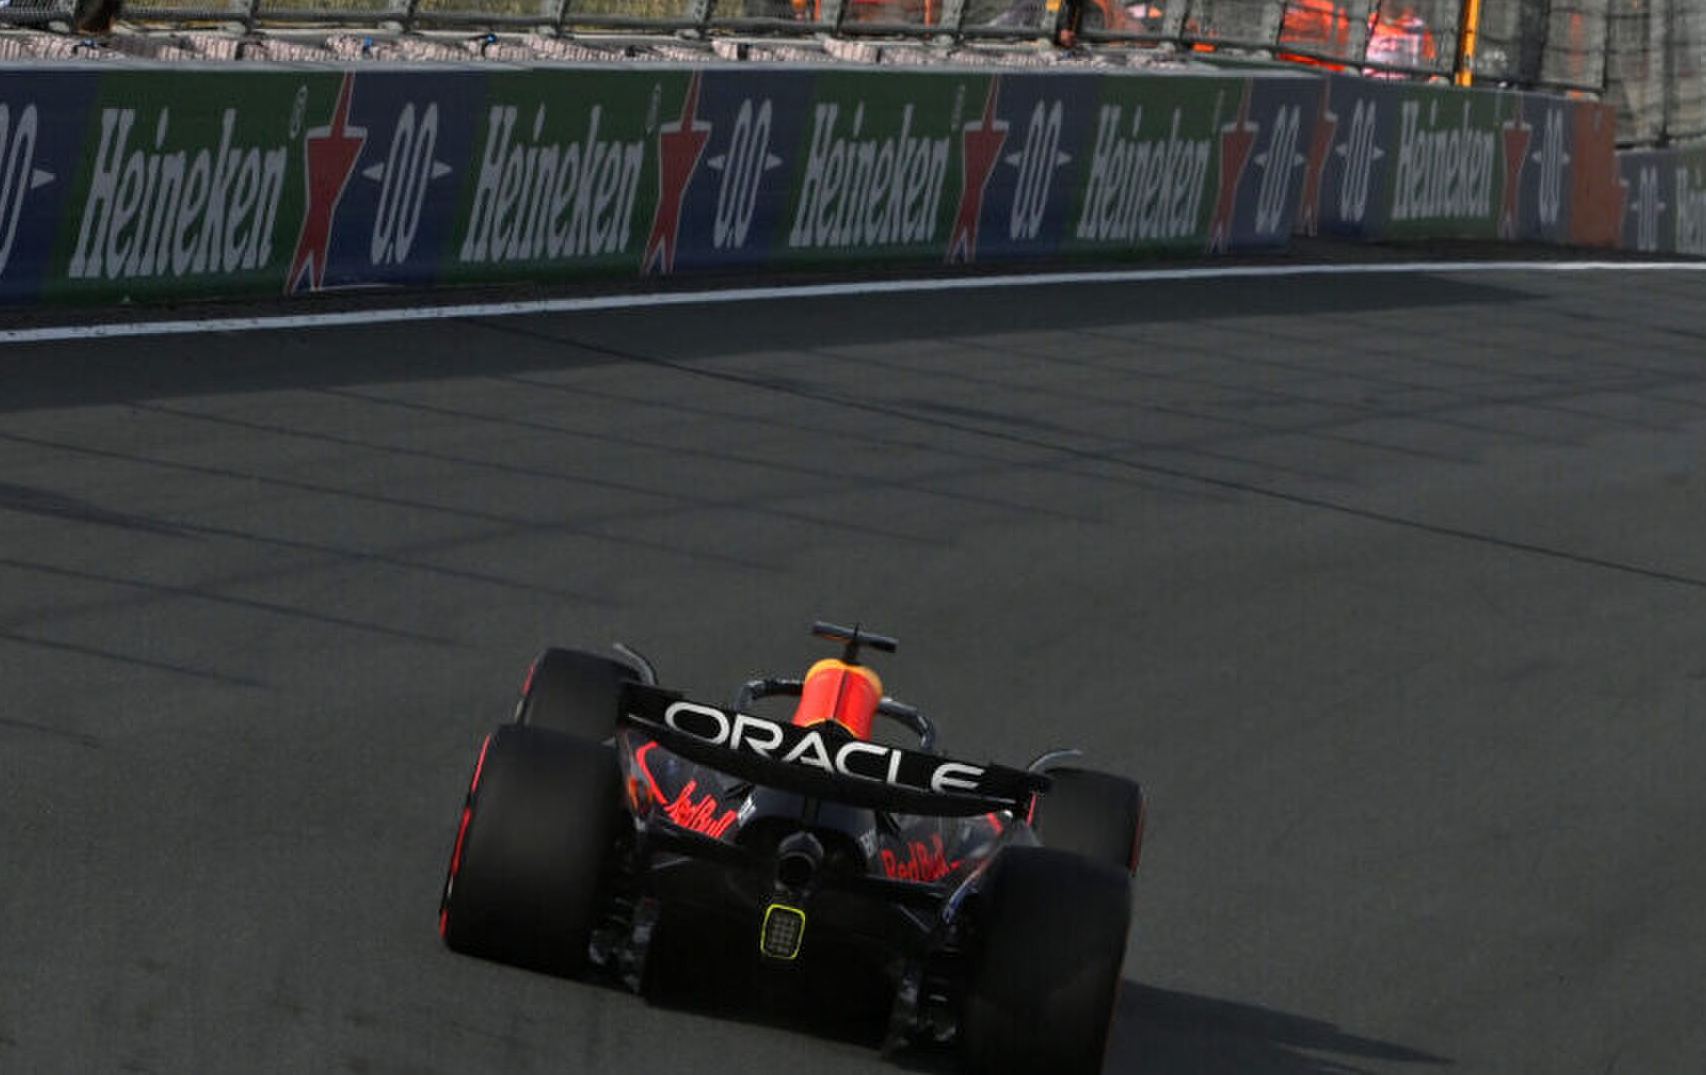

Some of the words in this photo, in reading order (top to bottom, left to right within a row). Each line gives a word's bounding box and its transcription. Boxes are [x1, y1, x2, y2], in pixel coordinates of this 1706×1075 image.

[69, 107, 289, 280] Heineken
[459, 102, 645, 263] Heineken
[789, 101, 950, 248] Heineken
[1076, 104, 1211, 240] Heineken
[1393, 99, 1494, 220] Heineken
[664, 701, 985, 793] ORACLE
